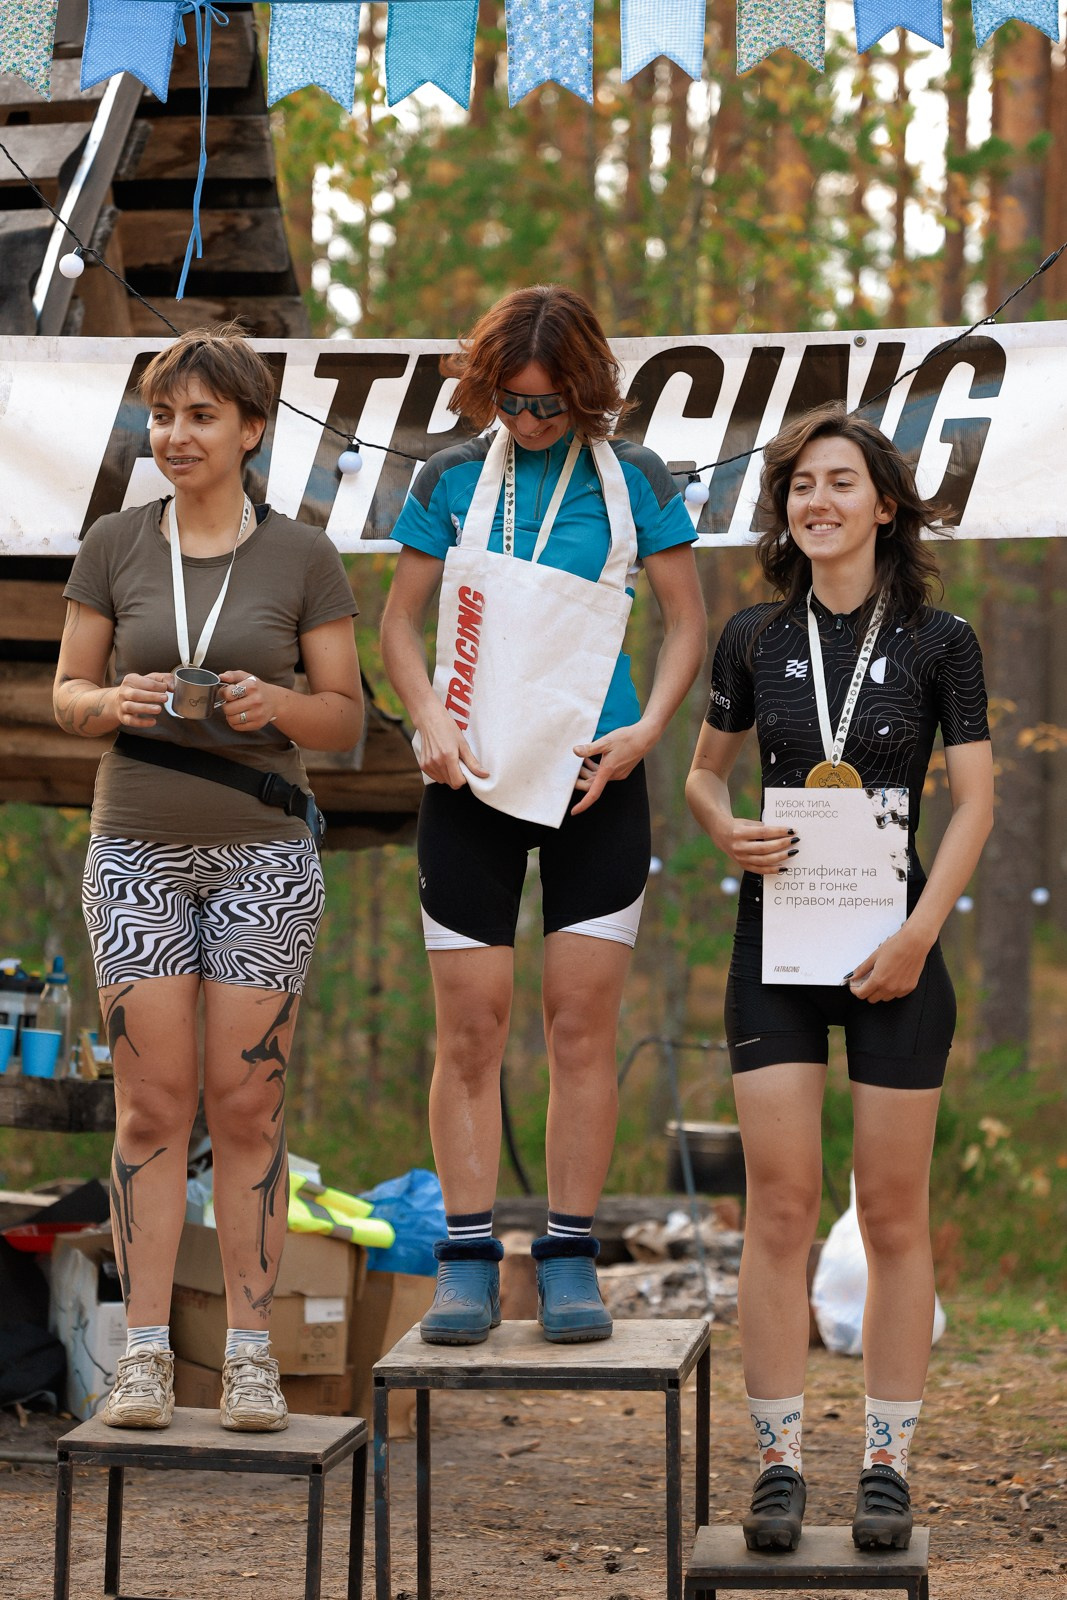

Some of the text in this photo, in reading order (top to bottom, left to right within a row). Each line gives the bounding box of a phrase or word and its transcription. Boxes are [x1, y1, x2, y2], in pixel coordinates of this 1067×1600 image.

[79, 335, 1007, 541] FTRCING
[444, 586, 486, 732] TRACING
[775, 800, 831, 808] КУБОК ТИПА
[775, 810, 839, 819] ЦИКЛОКРОСС
[861, 868, 877, 877] на
[774, 882, 858, 891] слот в гонке
[774, 896, 894, 909] с правом дарения
[774, 965, 801, 973] FATRACING
